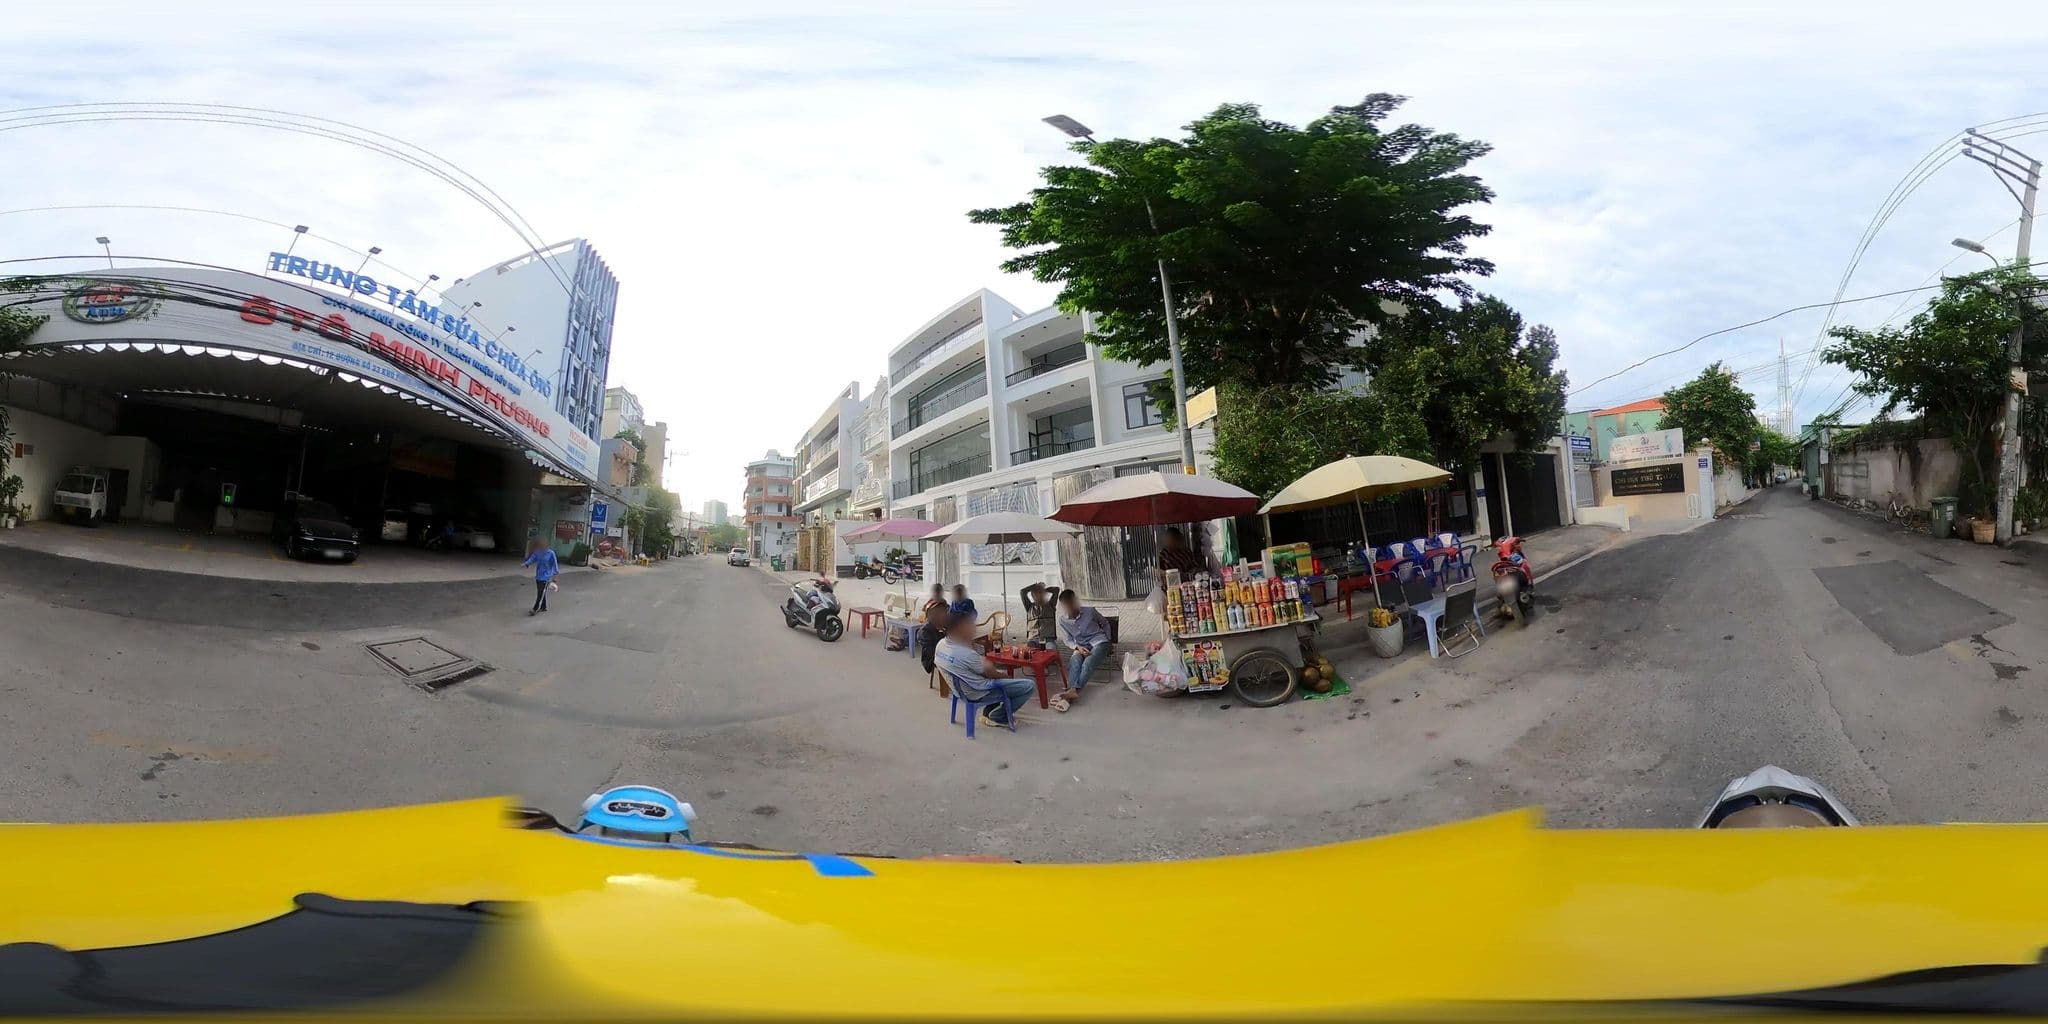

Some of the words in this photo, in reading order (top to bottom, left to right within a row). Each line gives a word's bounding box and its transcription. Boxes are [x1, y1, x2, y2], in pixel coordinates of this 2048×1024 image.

[270, 251, 378, 295] TRUNG
[386, 285, 438, 325] TÂM
[443, 314, 481, 350] SỬA
[485, 340, 526, 380] CHỮA
[397, 321, 430, 341] CÔNG
[431, 337, 442, 348] TY
[443, 344, 471, 365] TRÁCH
[369, 331, 460, 388] MINH
[468, 376, 551, 438] PHƯƠNG
